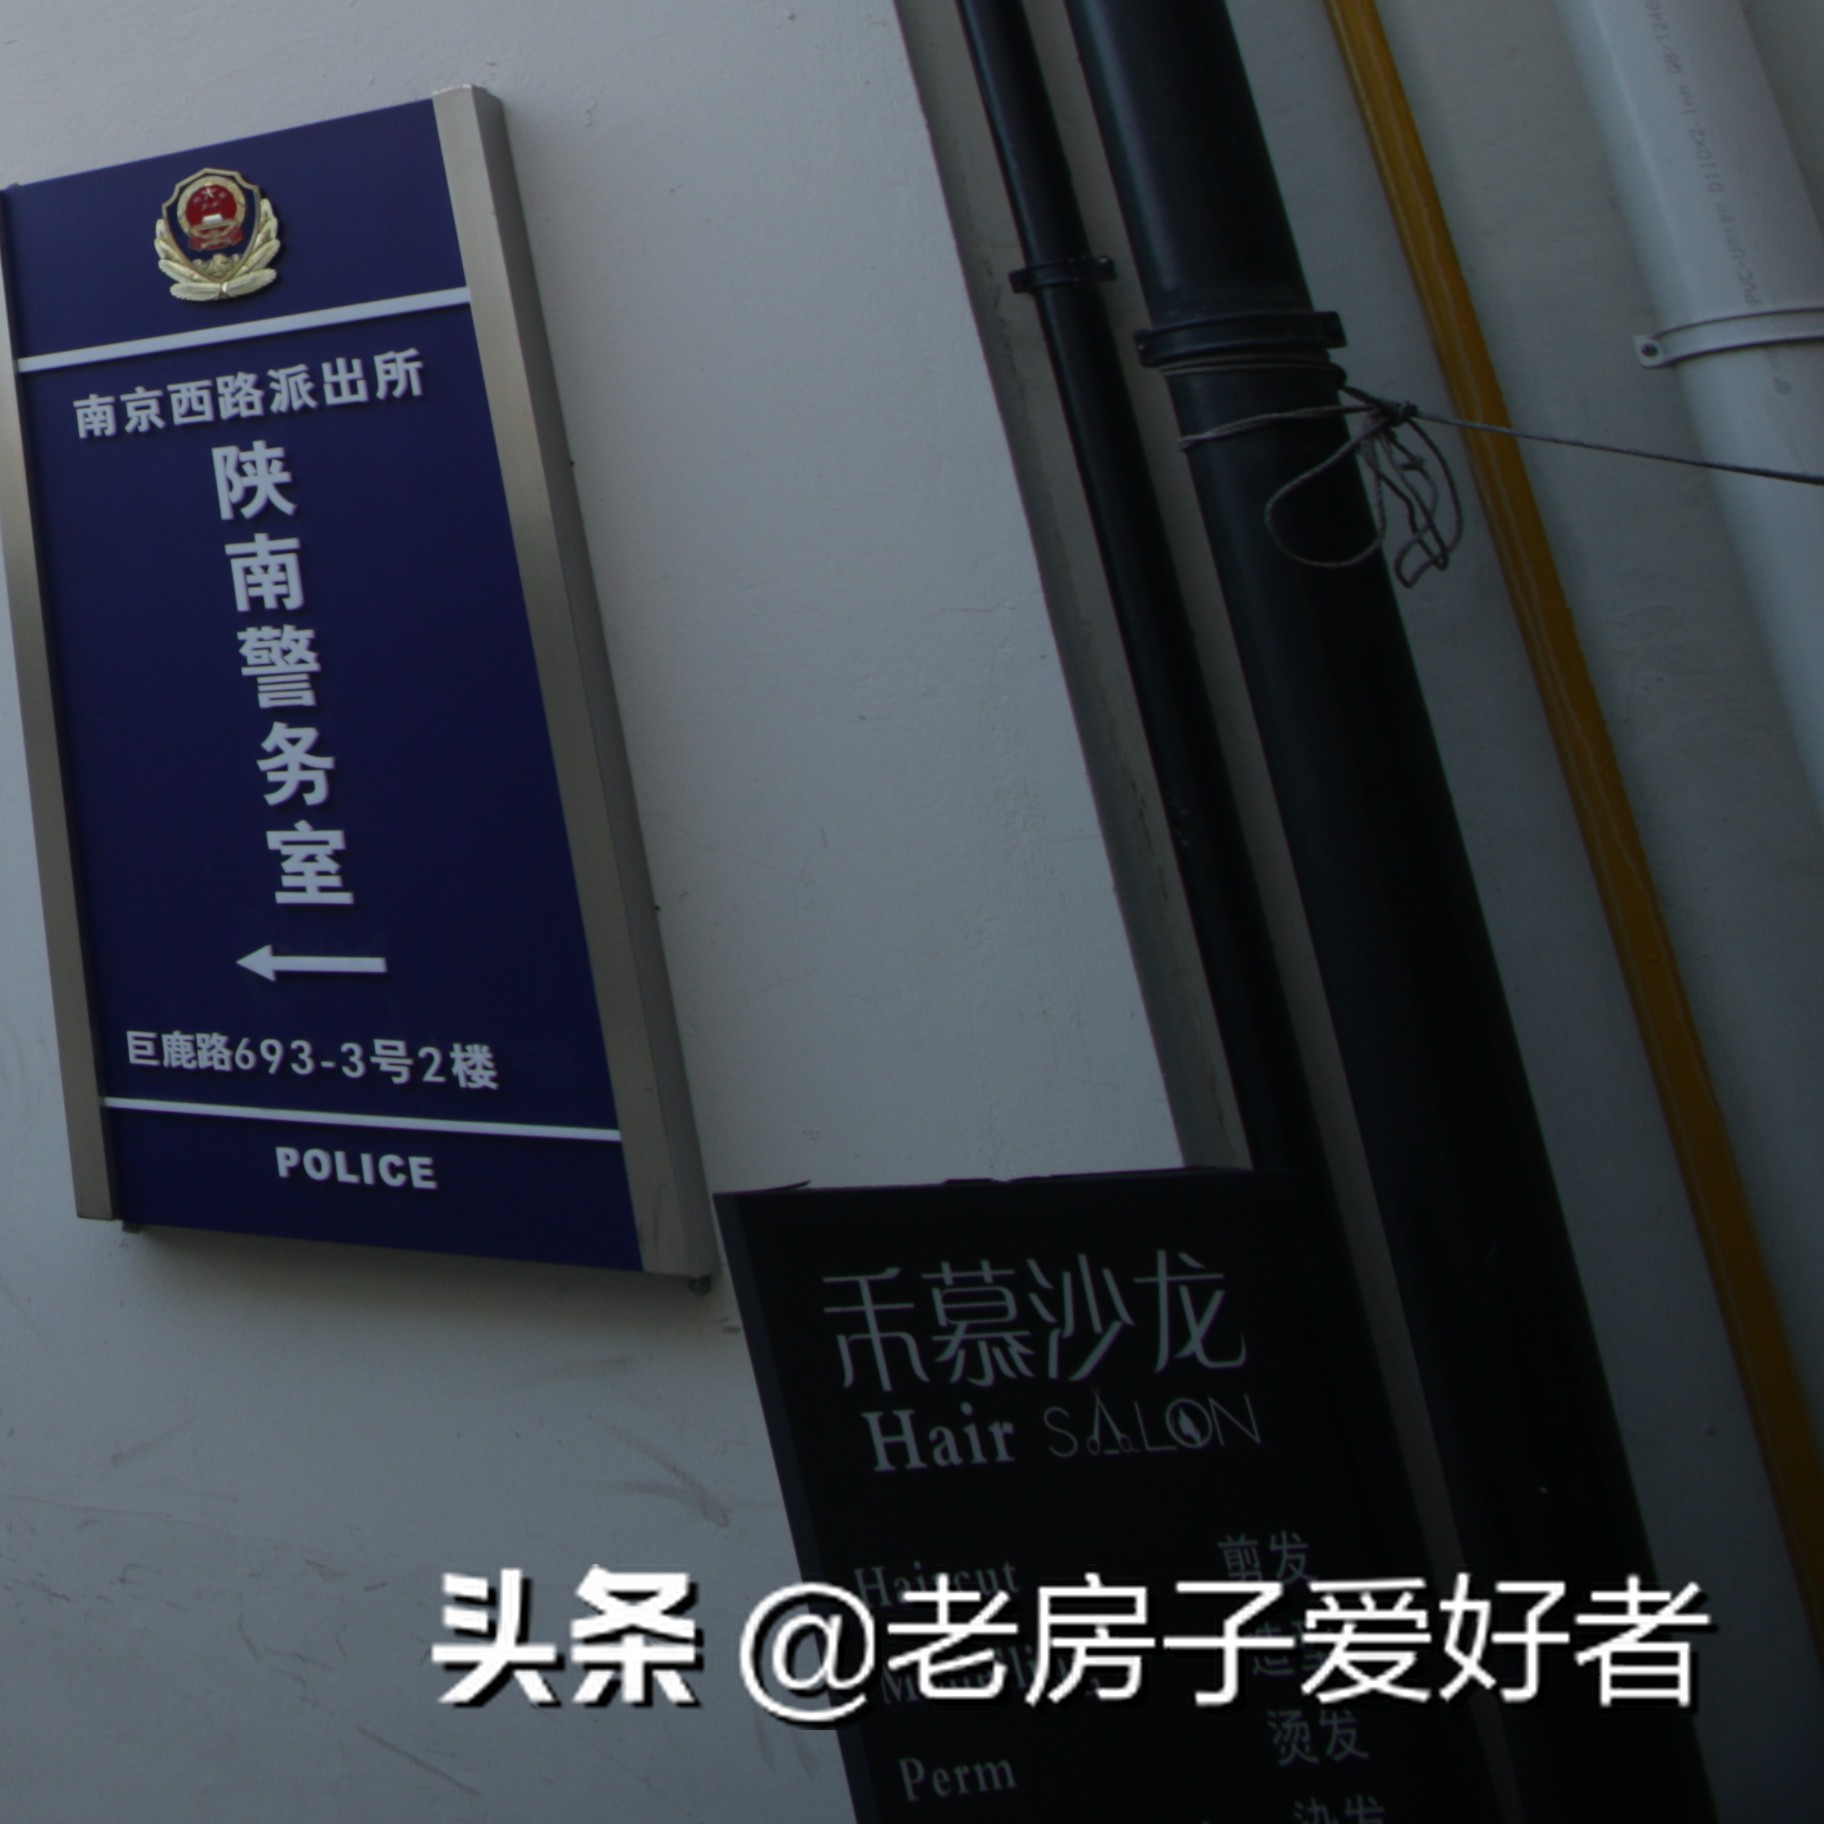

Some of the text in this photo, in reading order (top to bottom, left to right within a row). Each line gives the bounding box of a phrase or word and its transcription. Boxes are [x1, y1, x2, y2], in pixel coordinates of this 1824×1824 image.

[73, 347, 426, 440] 南京西路派出所
[211, 441, 354, 906] 陕南警务室
[125, 1029, 499, 1092] 巨鹿路693-3号2楼
[276, 1145, 437, 1191] POLICE
[822, 1249, 1247, 1392] 禾慕沙龙
[861, 1387, 1262, 1472] Hair SALON
[854, 1560, 1020, 1607] Haicut
[1266, 1707, 1371, 1767] 烫发
[898, 1757, 1017, 1803] Perm
